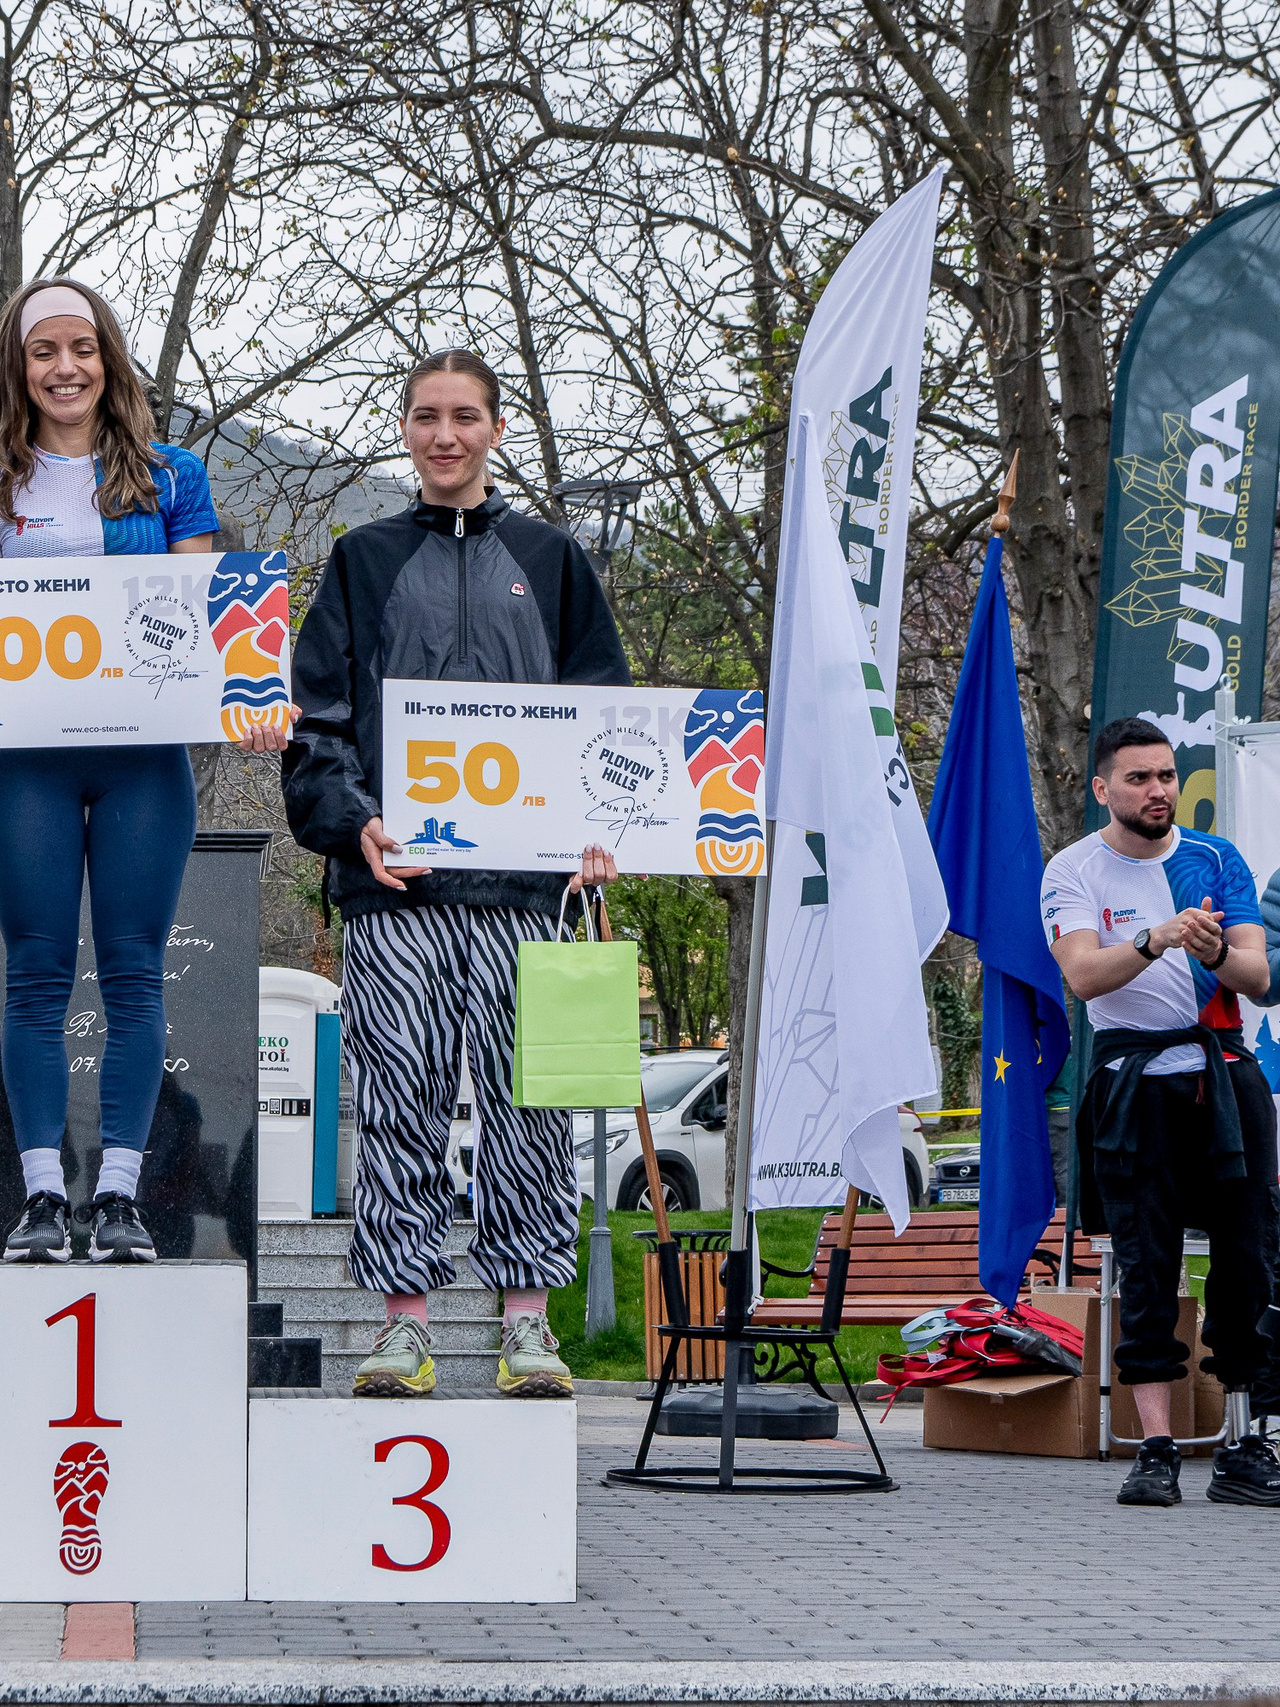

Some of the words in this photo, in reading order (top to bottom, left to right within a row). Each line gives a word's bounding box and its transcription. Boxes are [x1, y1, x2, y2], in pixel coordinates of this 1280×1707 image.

[1234, 464, 1253, 549] BORDER
[1244, 402, 1259, 457] RACE
[878, 451, 894, 536] BORDER
[1173, 374, 1249, 692] ULTRA
[33, 578, 90, 592] ЖЕНИ
[122, 575, 209, 618] 12K
[124, 597, 150, 625] PLOVDIV
[154, 595, 179, 604] HILLS
[180, 603, 189, 611] IN
[189, 612, 199, 651] MARKOVO
[139, 614, 187, 641] PLOVDIV
[124, 638, 139, 661] TRAIL
[142, 630, 174, 651] HILLS
[100, 666, 124, 679] лв
[451, 703, 517, 718] МЯСТО
[521, 705, 577, 720] ЖЕНИ
[600, 706, 688, 748] 12K
[61, 725, 139, 734] www.eco-steam.eu
[405, 739, 520, 806] 50
[522, 795, 546, 807] лв
[581, 729, 612, 760] PLOVDIV
[617, 727, 645, 738] HILLS
[647, 737, 658, 747] IN
[656, 748, 669, 794] MARKOVO
[598, 747, 654, 781] PLOVDIV
[580, 775, 597, 801] TRAIL
[600, 800, 619, 813] RUN
[601, 767, 639, 792] HILLS
[409, 846, 425, 855] ECO
[537, 851, 584, 859] www.eco-st
[259, 1036, 289, 1048] EKO
[45, 1292, 122, 1427] 1
[371, 1434, 451, 1573] 3
